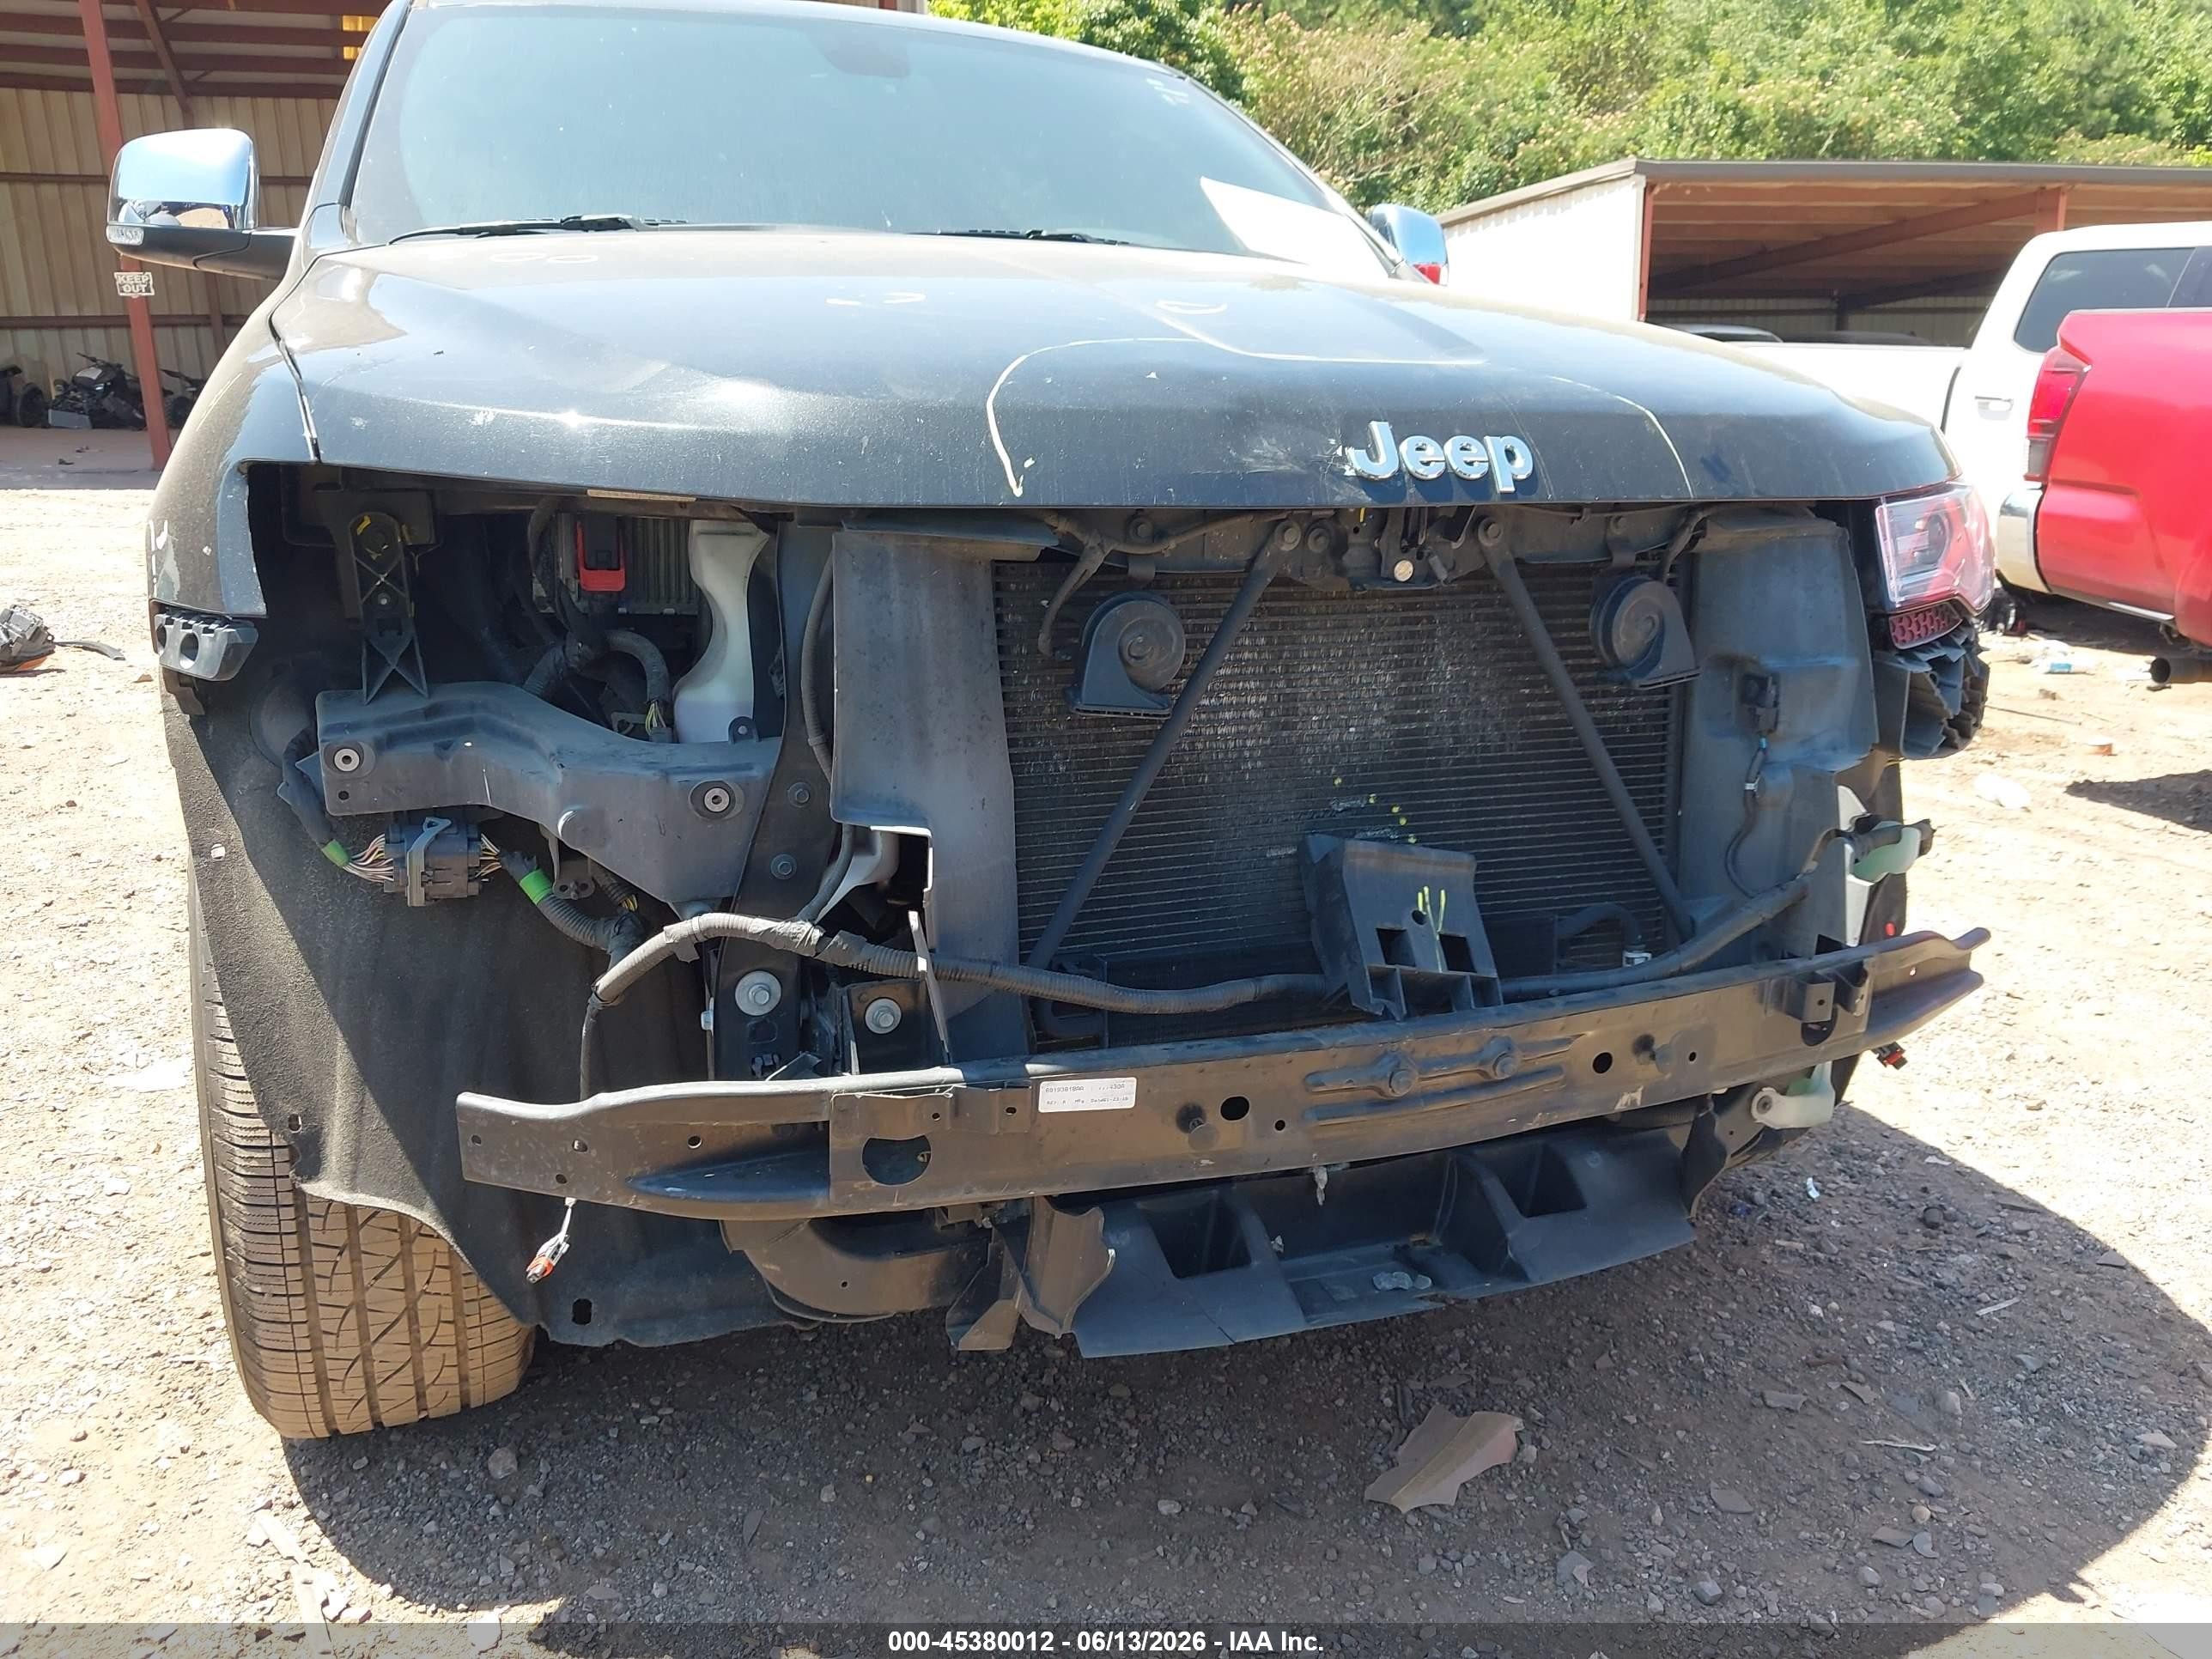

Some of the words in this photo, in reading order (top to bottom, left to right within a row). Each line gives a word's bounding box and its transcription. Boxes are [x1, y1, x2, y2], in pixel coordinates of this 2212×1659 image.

[117, 275, 149, 284] KEEP
[122, 283, 148, 293] OUT
[1345, 420, 1534, 494] Jeep
